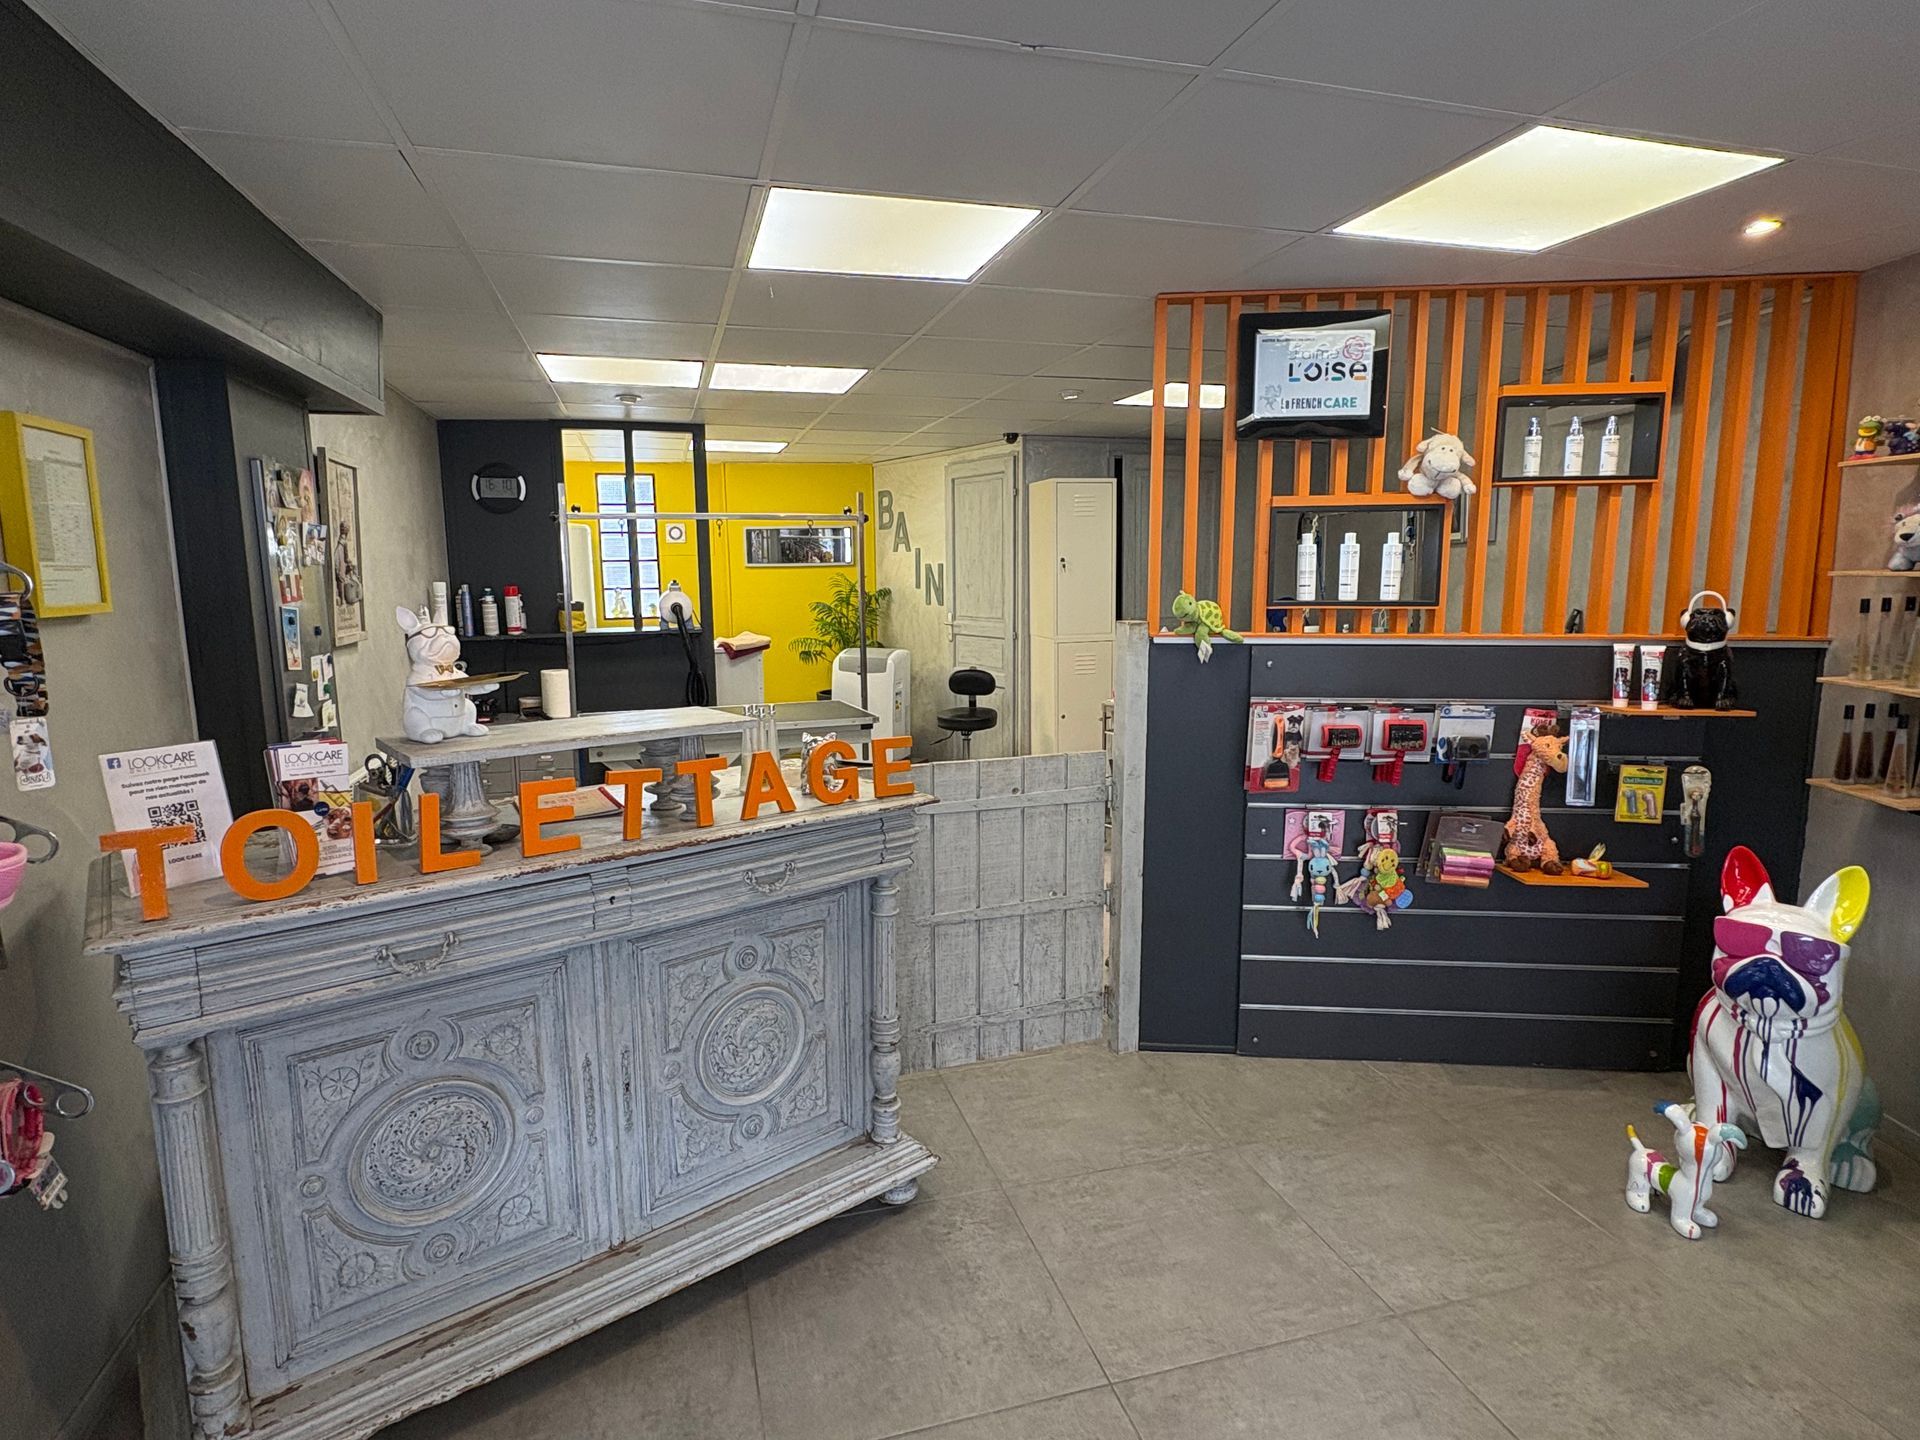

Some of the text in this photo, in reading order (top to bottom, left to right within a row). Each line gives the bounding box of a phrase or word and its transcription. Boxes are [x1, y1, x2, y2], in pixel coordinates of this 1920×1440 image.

[1291, 397, 1322, 410] FRENCH
[1323, 396, 1358, 408] CARE
[878, 490, 944, 607] BAIN
[128, 751, 196, 769] LOOKCARE
[284, 750, 342, 765] LOOKCARE
[99, 736, 915, 920] TOILETTAGE
[168, 853, 203, 864] LOOK CARE
